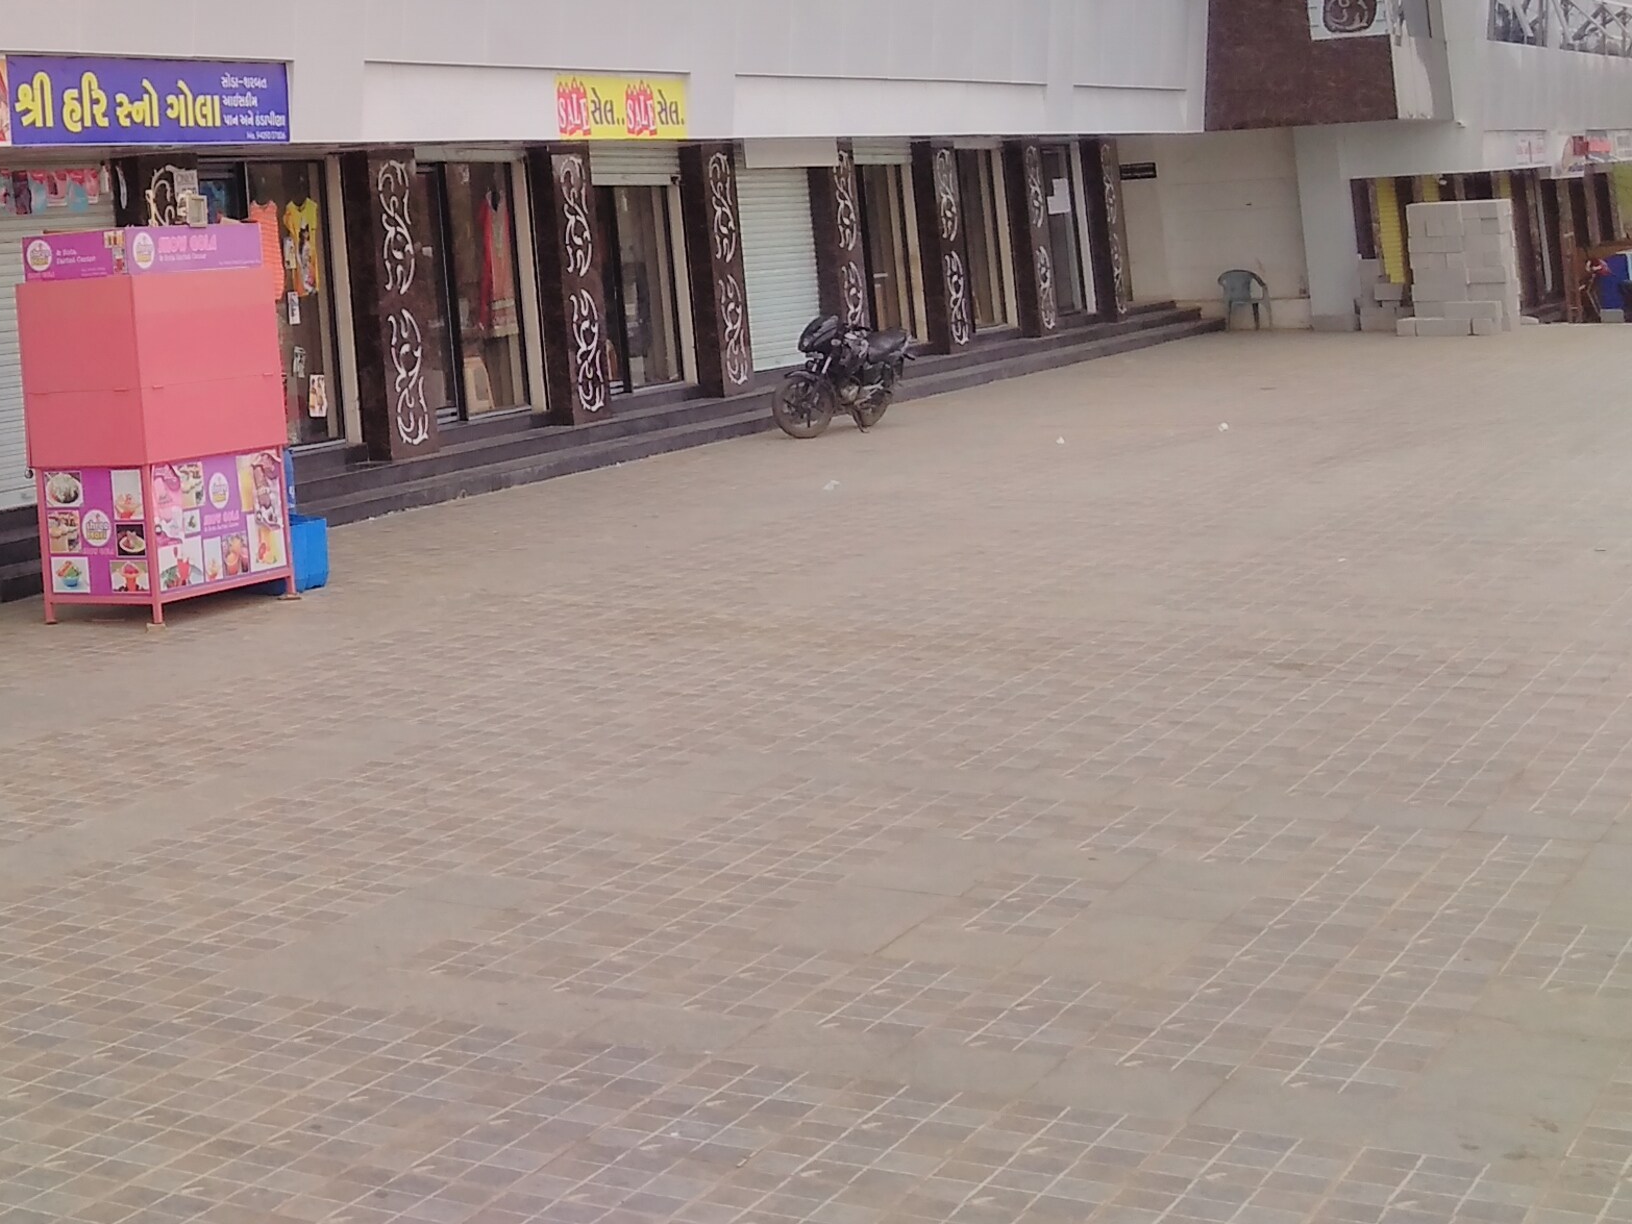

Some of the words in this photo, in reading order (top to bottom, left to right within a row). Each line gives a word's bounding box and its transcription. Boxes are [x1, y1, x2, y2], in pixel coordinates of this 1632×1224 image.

[14, 71, 55, 128] શ્રી
[62, 71, 110, 134] હરિ
[115, 78, 161, 128] સ્નો
[165, 79, 223, 128] ગોલા
